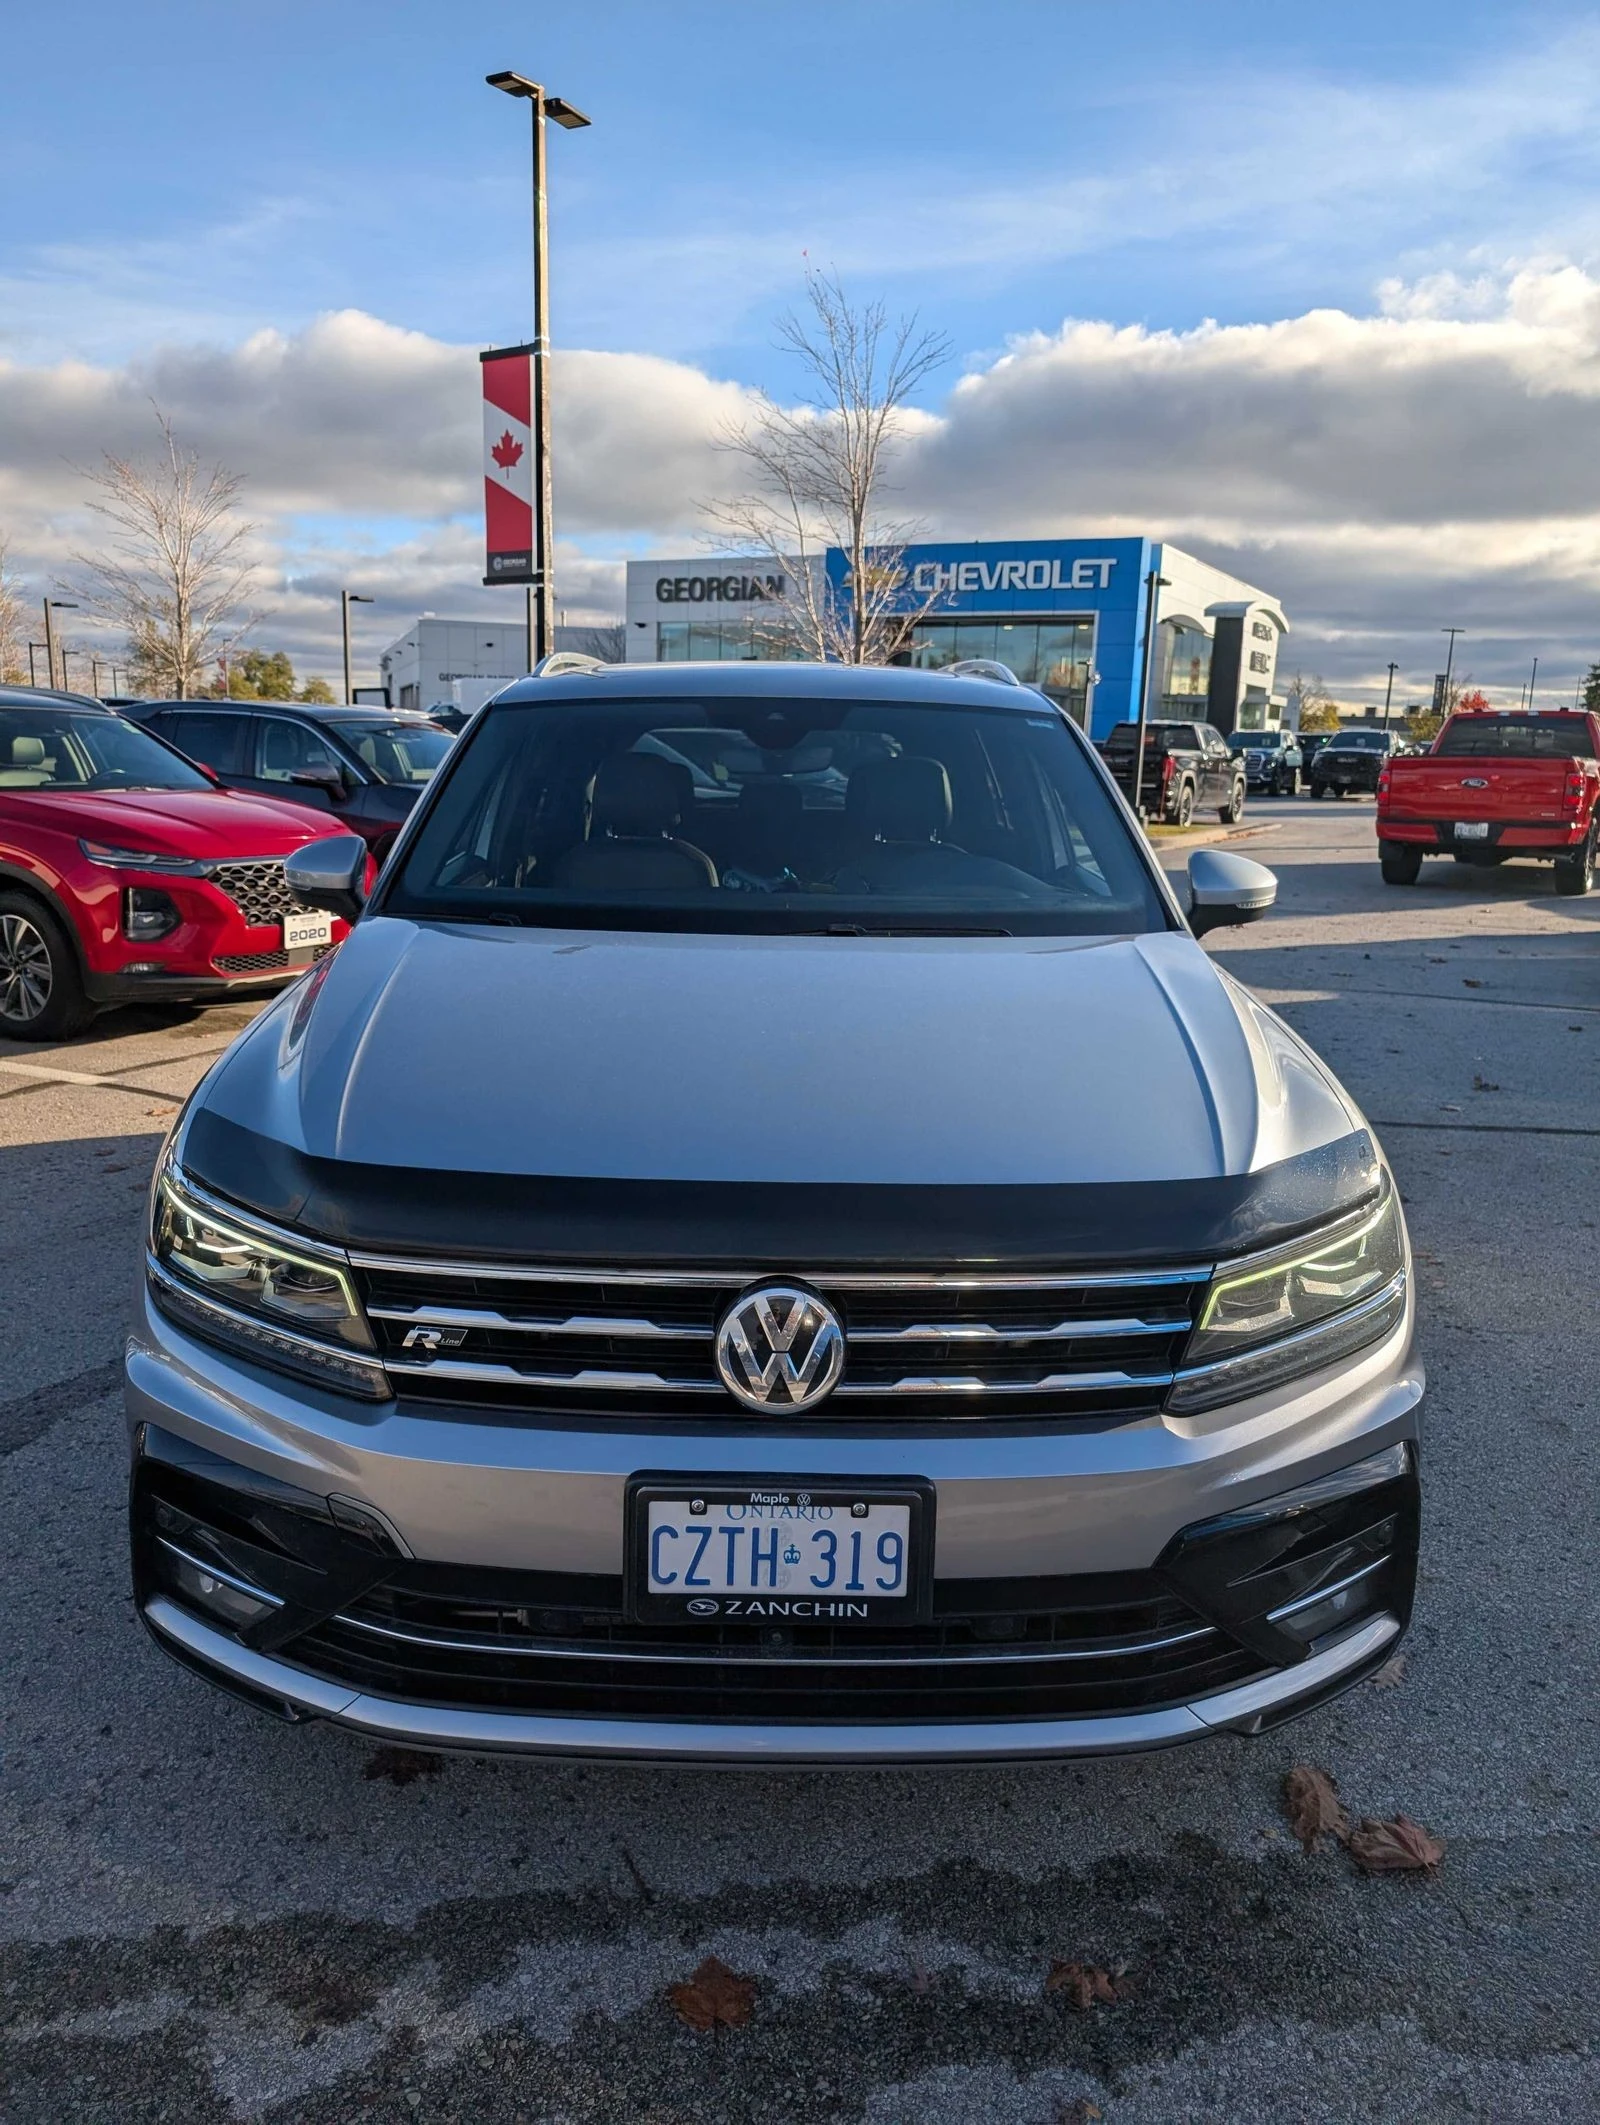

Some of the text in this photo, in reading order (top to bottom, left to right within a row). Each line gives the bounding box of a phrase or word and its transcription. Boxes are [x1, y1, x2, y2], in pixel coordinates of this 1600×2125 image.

[913, 558, 1118, 592] CHEVROLET
[656, 575, 785, 602] GEORGIAN
[290, 927, 327, 941] 2020
[750, 1493, 790, 1505] Maple
[726, 1504, 833, 1523] ONTARIO
[652, 1525, 903, 1591] CZTH 319
[725, 1600, 868, 1618] ZANCHIN
